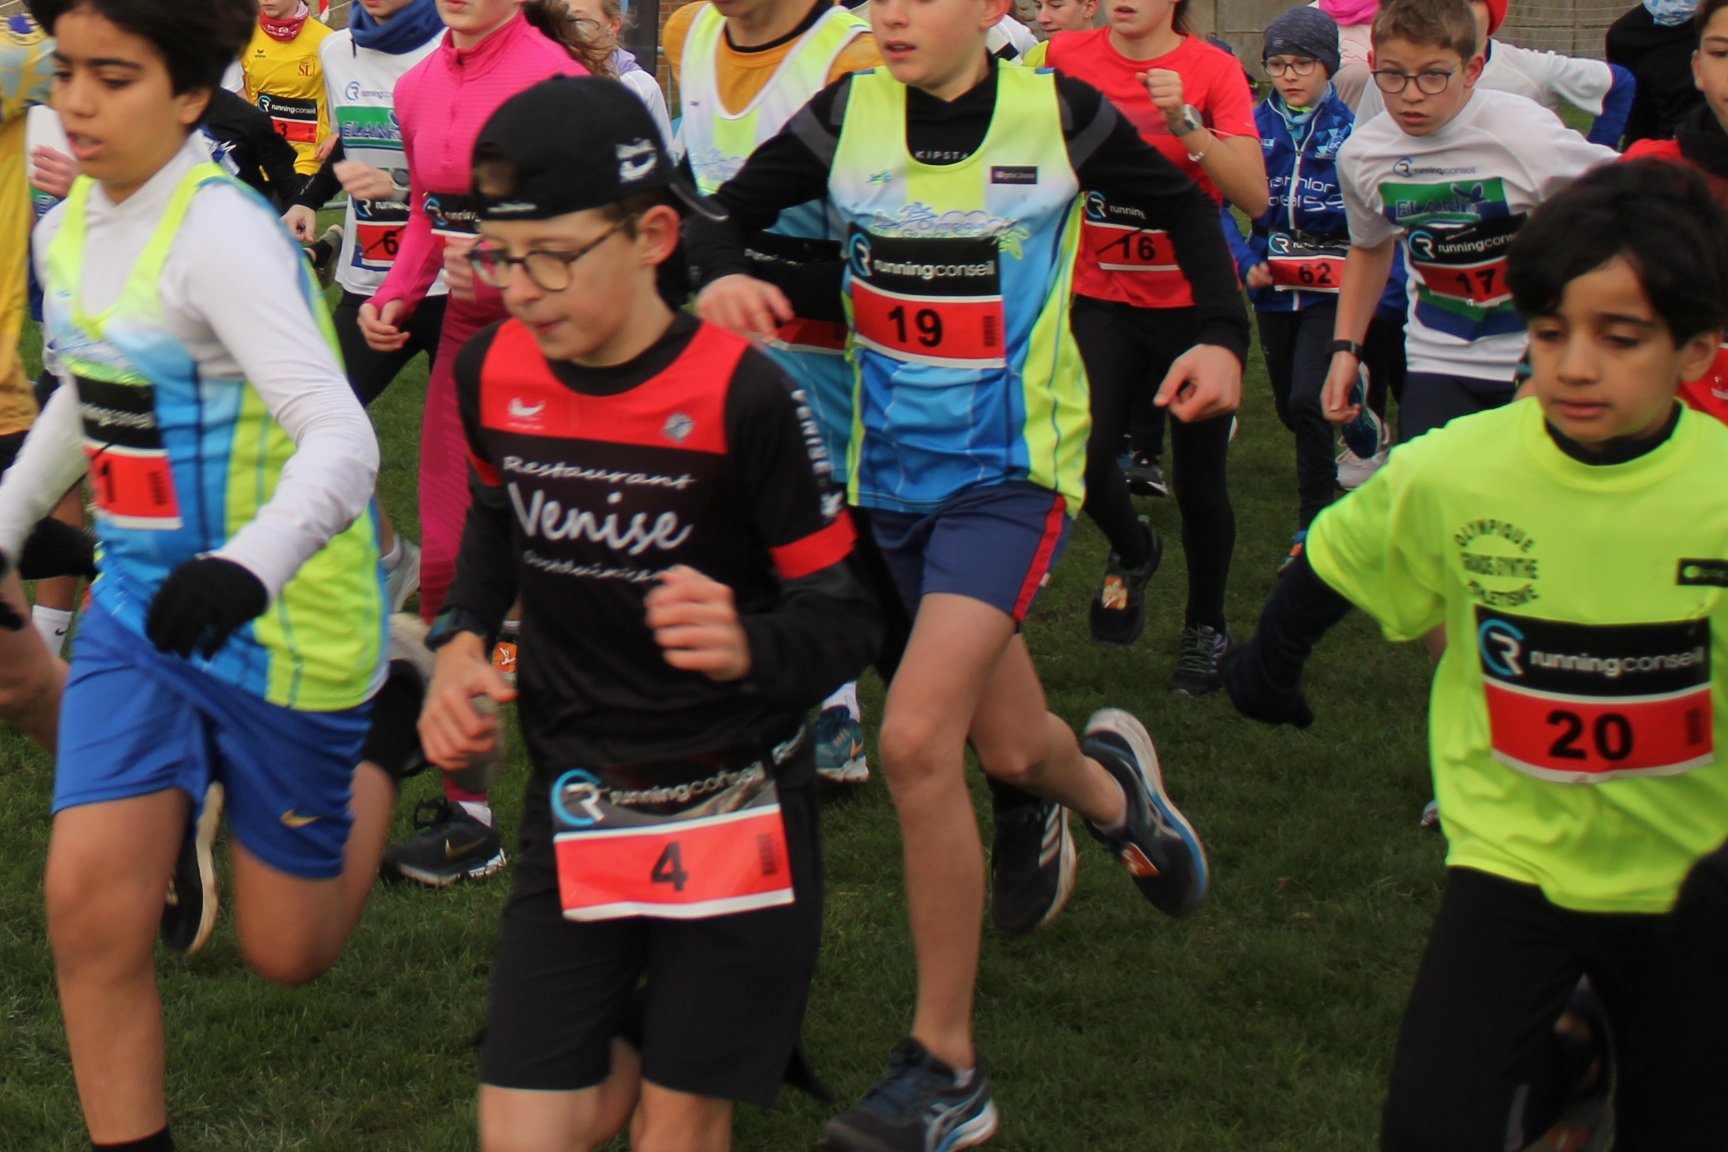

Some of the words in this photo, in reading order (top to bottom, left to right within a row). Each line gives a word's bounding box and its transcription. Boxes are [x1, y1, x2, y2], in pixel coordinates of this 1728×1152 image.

[1117, 234, 1156, 261] 16
[873, 258, 996, 280] runningconseil
[1299, 263, 1333, 285] 62
[1455, 268, 1497, 295] 17
[888, 305, 943, 348] 19
[502, 455, 698, 490] Restaurant
[507, 481, 695, 556] Venise
[1529, 645, 1706, 679] runningconseil
[1546, 709, 1635, 763] 20
[650, 840, 690, 893] 4
